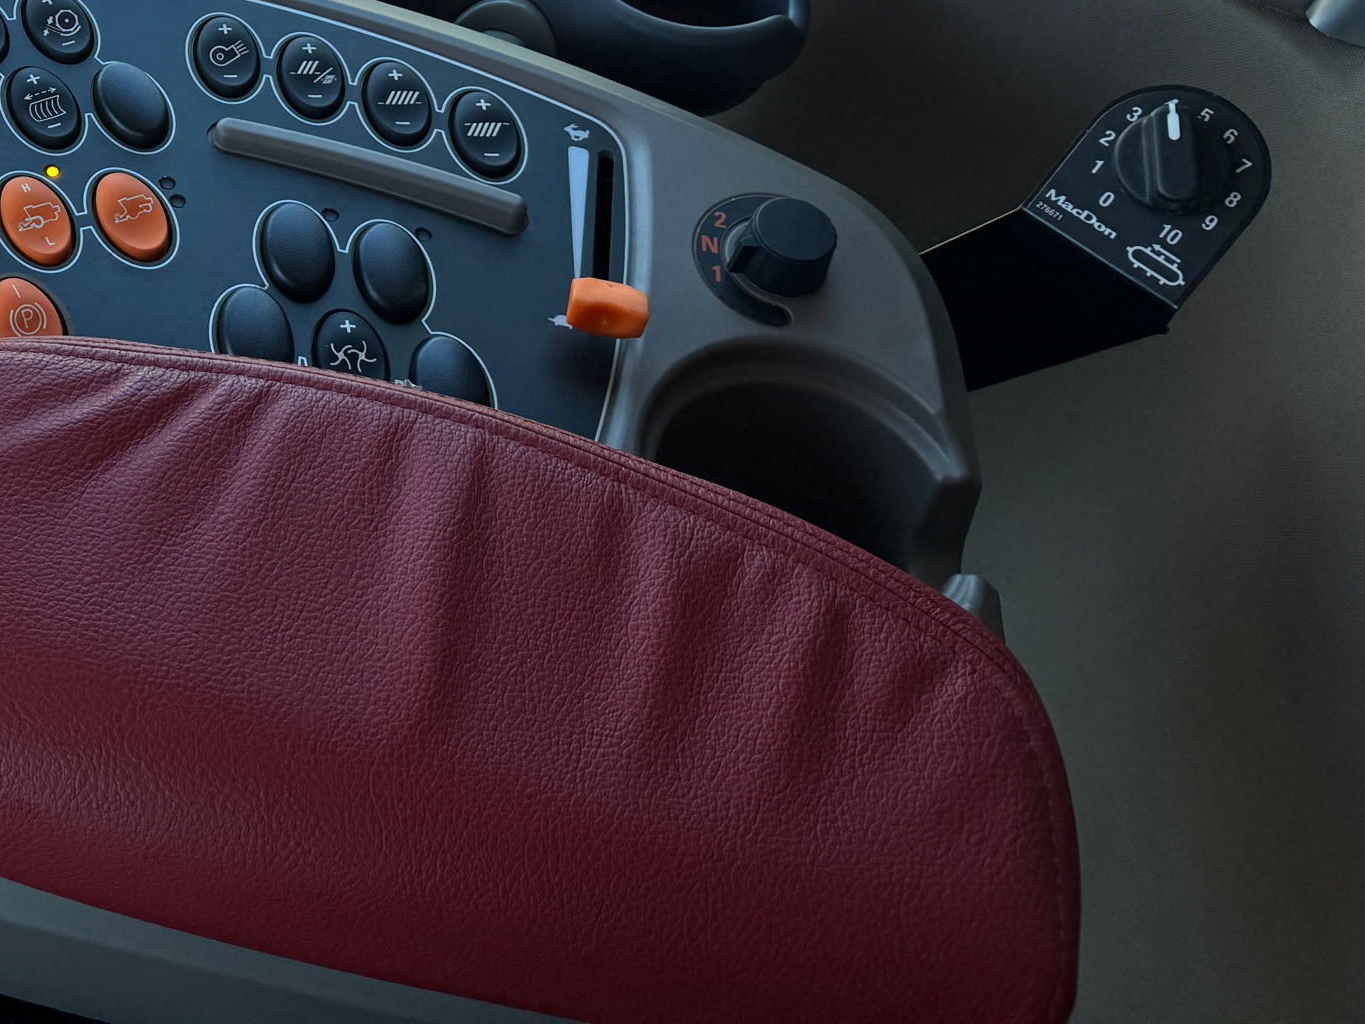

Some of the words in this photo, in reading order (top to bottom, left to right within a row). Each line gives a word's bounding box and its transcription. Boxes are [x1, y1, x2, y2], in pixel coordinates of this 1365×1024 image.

[1126, 106, 1143, 123] 3
[1197, 107, 1215, 123] 5
[1098, 130, 1116, 147] 2
[1222, 128, 1239, 145] 6
[1090, 160, 1105, 174] 1
[1235, 158, 1253, 174] 7
[21, 183, 31, 193] H
[1098, 191, 1115, 208] 0
[1224, 191, 1242, 208] 8
[713, 211, 728, 229] 2
[1035, 201, 1063, 222] 276671
[1045, 188, 1117, 240] MacDon
[1201, 215, 1219, 232] 9
[45, 236, 55, 247] L
[1157, 224, 1183, 245] 10
[700, 235, 719, 254] N
[712, 265, 722, 282] 1
[21, 308, 34, 328] P
